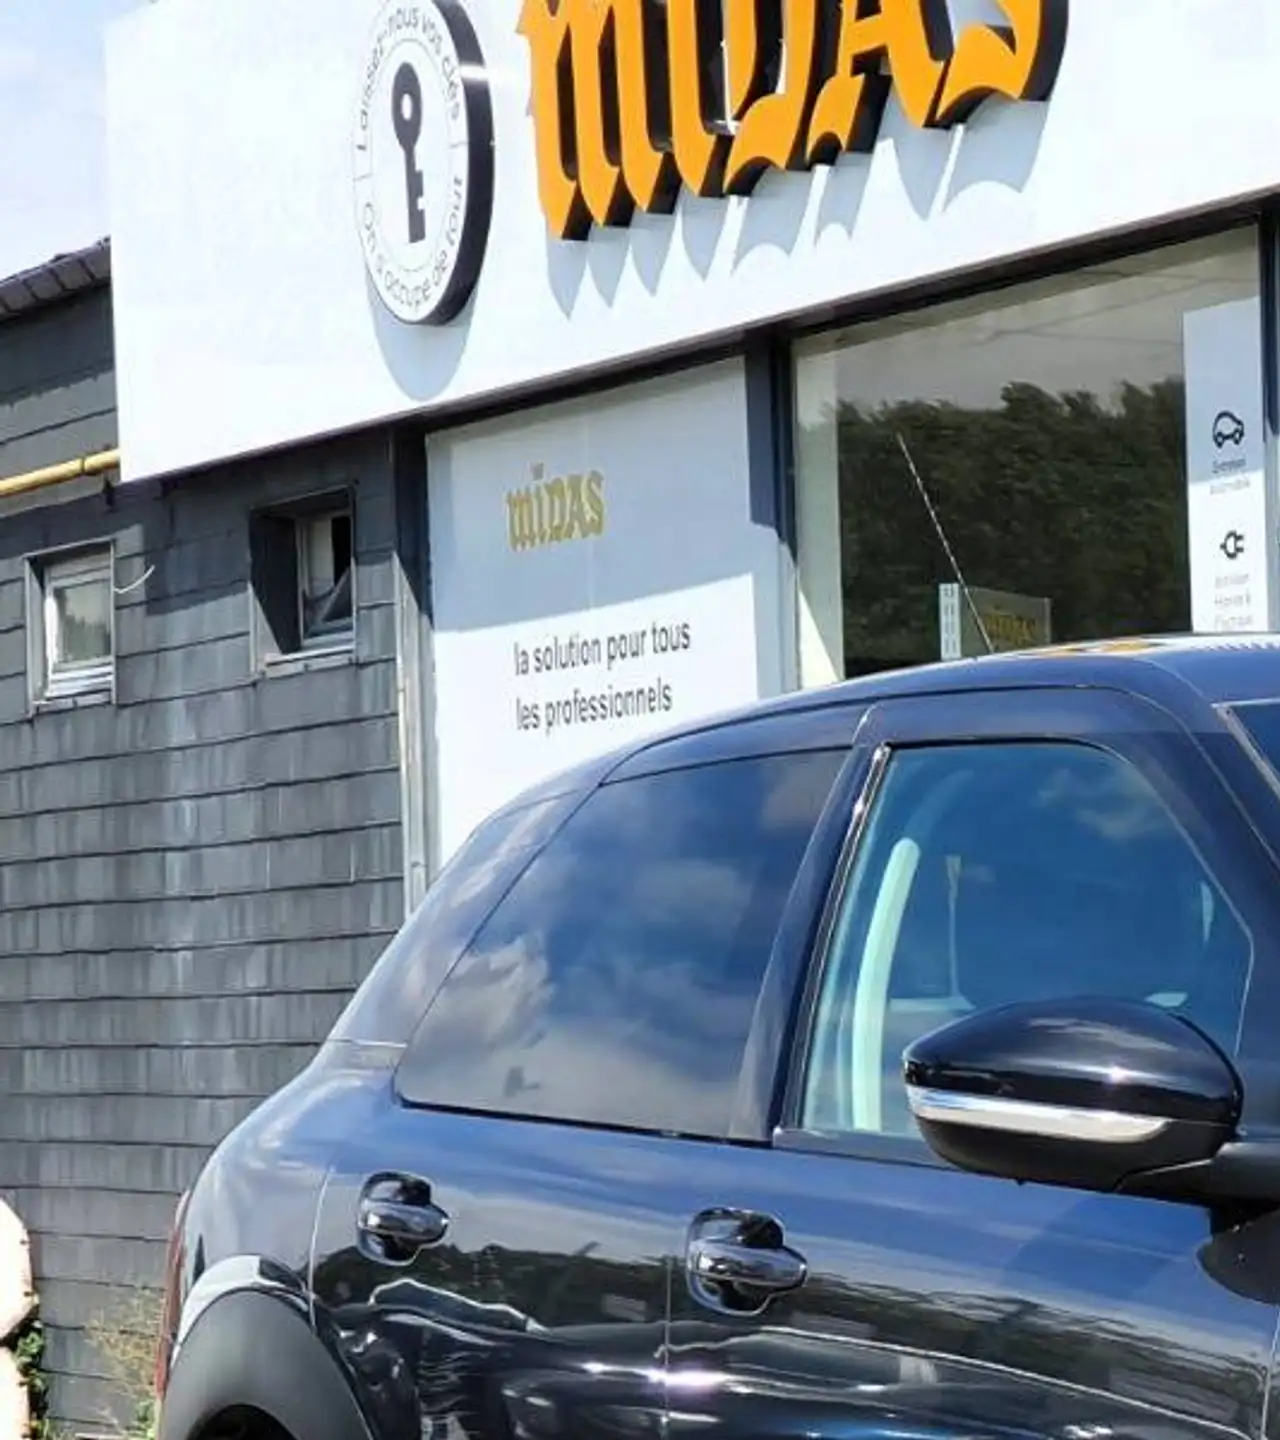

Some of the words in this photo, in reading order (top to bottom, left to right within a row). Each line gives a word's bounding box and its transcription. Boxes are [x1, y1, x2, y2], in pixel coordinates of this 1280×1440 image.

[514, 642, 529, 676] la
[534, 633, 601, 674] solution
[606, 629, 646, 671] pour
[652, 620, 692, 653] tous
[515, 698, 541, 731] les
[545, 677, 673, 737] professionnels
